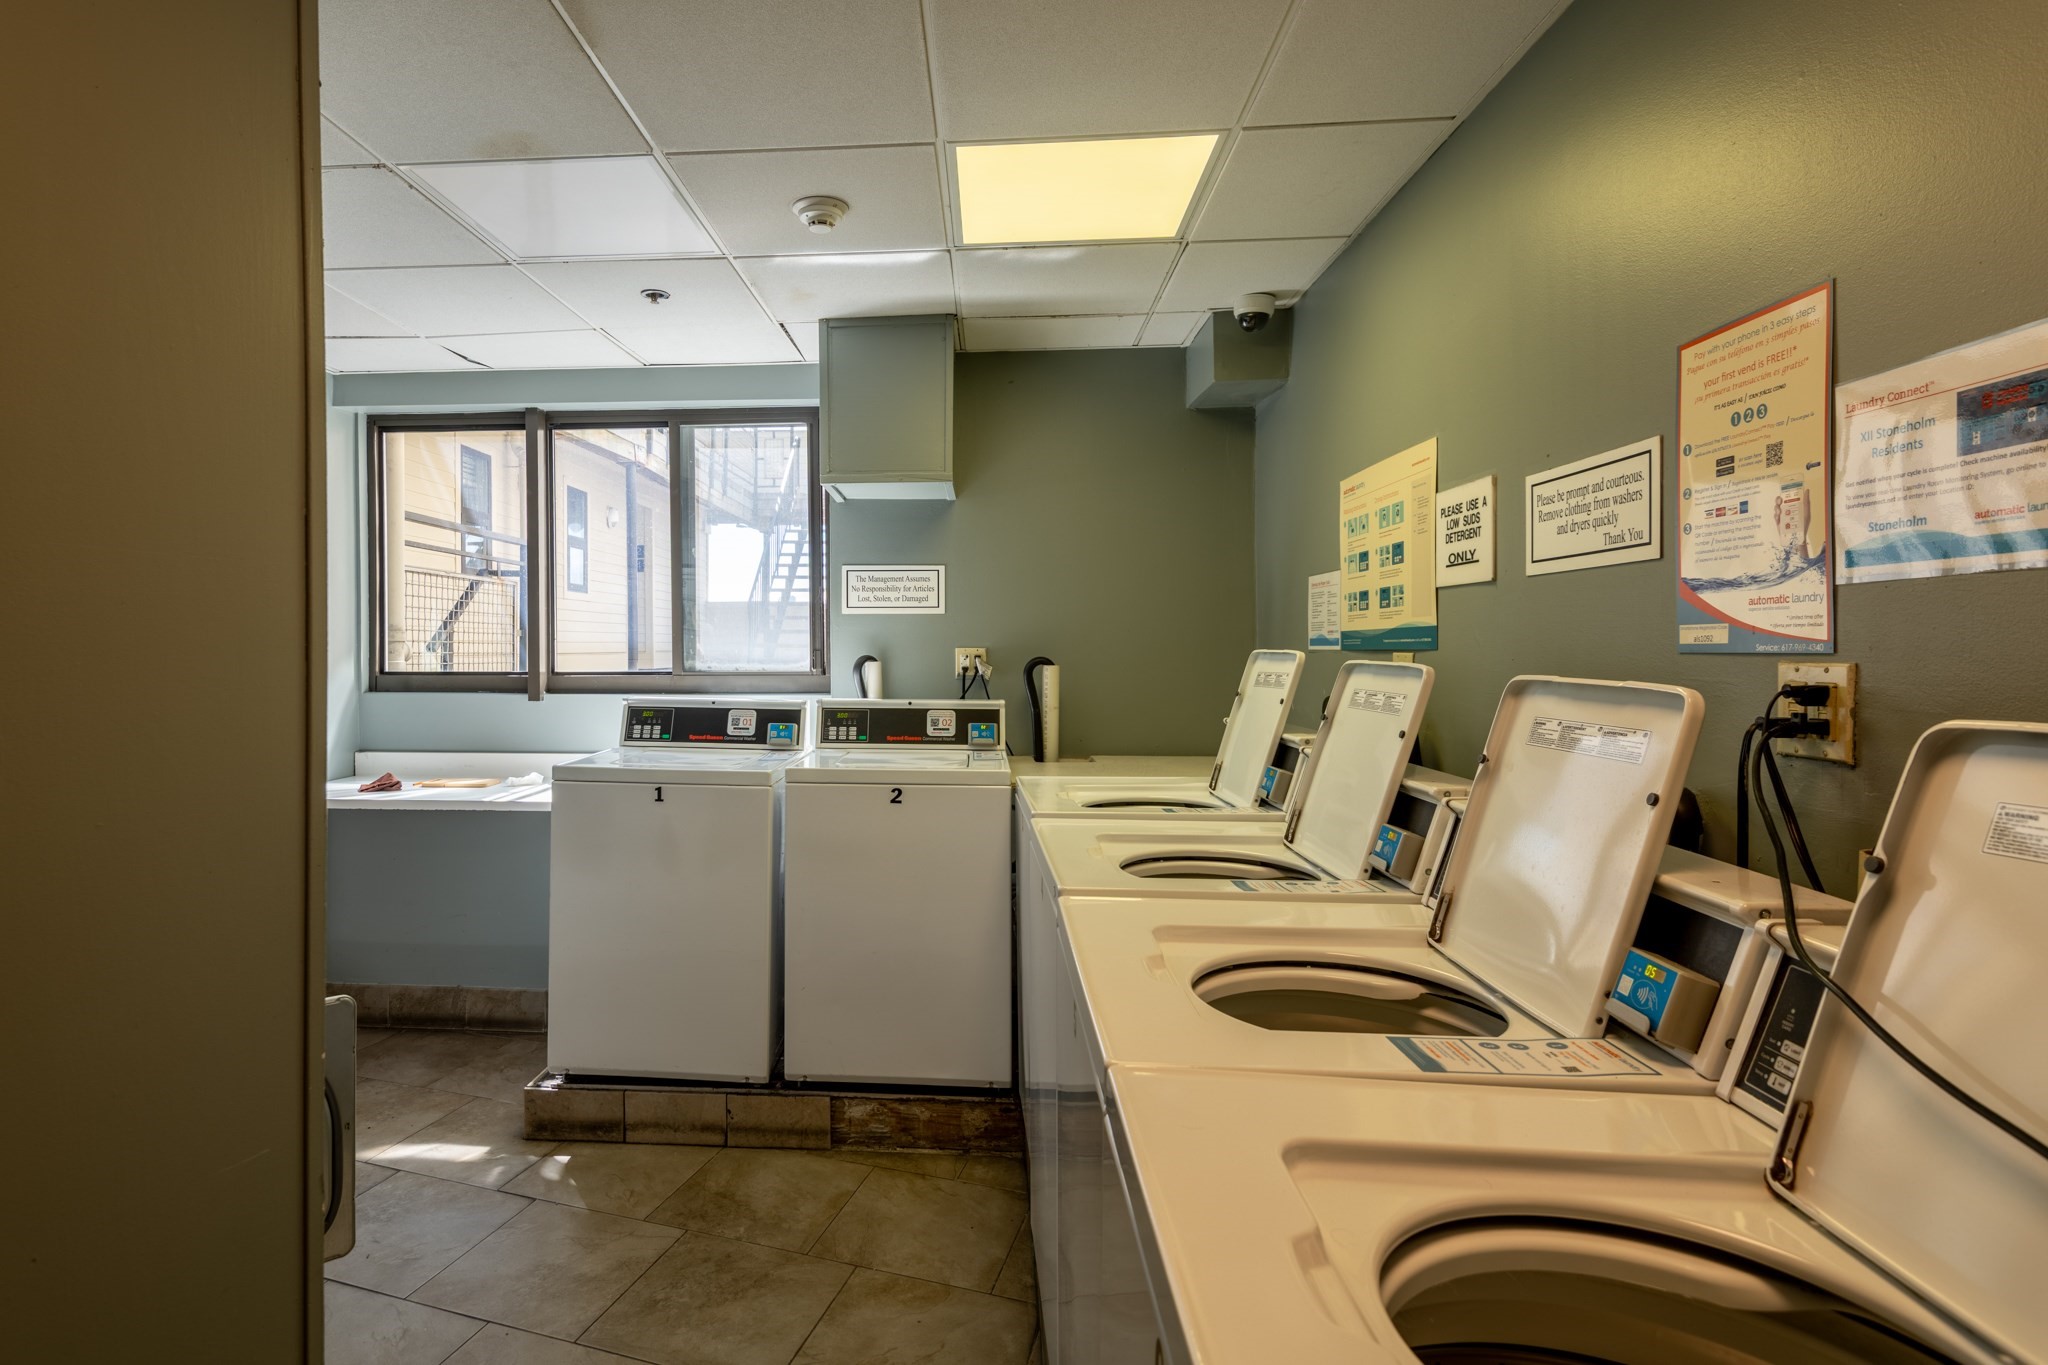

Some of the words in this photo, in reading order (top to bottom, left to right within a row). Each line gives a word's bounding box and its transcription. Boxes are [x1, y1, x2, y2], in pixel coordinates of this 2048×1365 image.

[1694, 350, 1706, 361] Pay
[1706, 344, 1720, 355] with
[1722, 338, 1736, 350] your
[1737, 328, 1760, 344] phone
[1762, 324, 1768, 334] in
[1770, 321, 1775, 330] 3
[1776, 315, 1794, 328] easy
[1796, 305, 1816, 320] steps
[1704, 376, 1719, 390] your
[1722, 369, 1736, 382] first
[1738, 362, 1756, 376] vend
[1758, 359, 1764, 368] is
[1845, 395, 1885, 414] Laundry
[1860, 430, 1873, 443] XII
[1875, 416, 1936, 440] Stoneholm
[1872, 438, 1924, 459] Residents
[1907, 469, 1921, 478] cycle
[1960, 458, 1978, 467] Check
[1980, 453, 2008, 462] machine
[1903, 483, 1926, 492] Laundry
[2016, 463, 2037, 472] online
[1536, 494, 1555, 508] Please
[1556, 489, 1565, 501] be
[1566, 484, 1590, 505] prompt
[1592, 476, 1605, 494] and
[1606, 470, 1645, 490] courteous.
[1440, 502, 1464, 519] PLEASE
[1466, 498, 1479, 511] USE
[1482, 496, 1488, 507] A
[1538, 508, 1563, 523] Remove
[1564, 498, 1592, 520] clothing
[1593, 497, 1611, 511] from
[1612, 488, 1643, 506] washers
[1974, 504, 2025, 519] automatic
[2027, 502, 2048, 512] laun
[1446, 518, 1460, 531] LOW
[1462, 512, 1481, 527] SUDS
[1556, 521, 1568, 535] and
[1570, 519, 1590, 536] dryers
[1592, 510, 1619, 532] quickly
[1868, 515, 1927, 533] Stoneholm
[1446, 526, 1482, 545] DETERGENT
[1603, 530, 1626, 546] Thank
[1628, 527, 1644, 542] You
[1448, 549, 1477, 564] ONLY
[862, 585, 901, 594] Responsibility
[868, 576, 904, 584] Management
[902, 595, 929, 603] Damaged
[1748, 594, 1790, 606] automatic
[1792, 592, 1824, 604] laundry
[742, 718, 752, 726] 01
[654, 786, 664, 802] 1
[890, 788, 903, 804] 2
